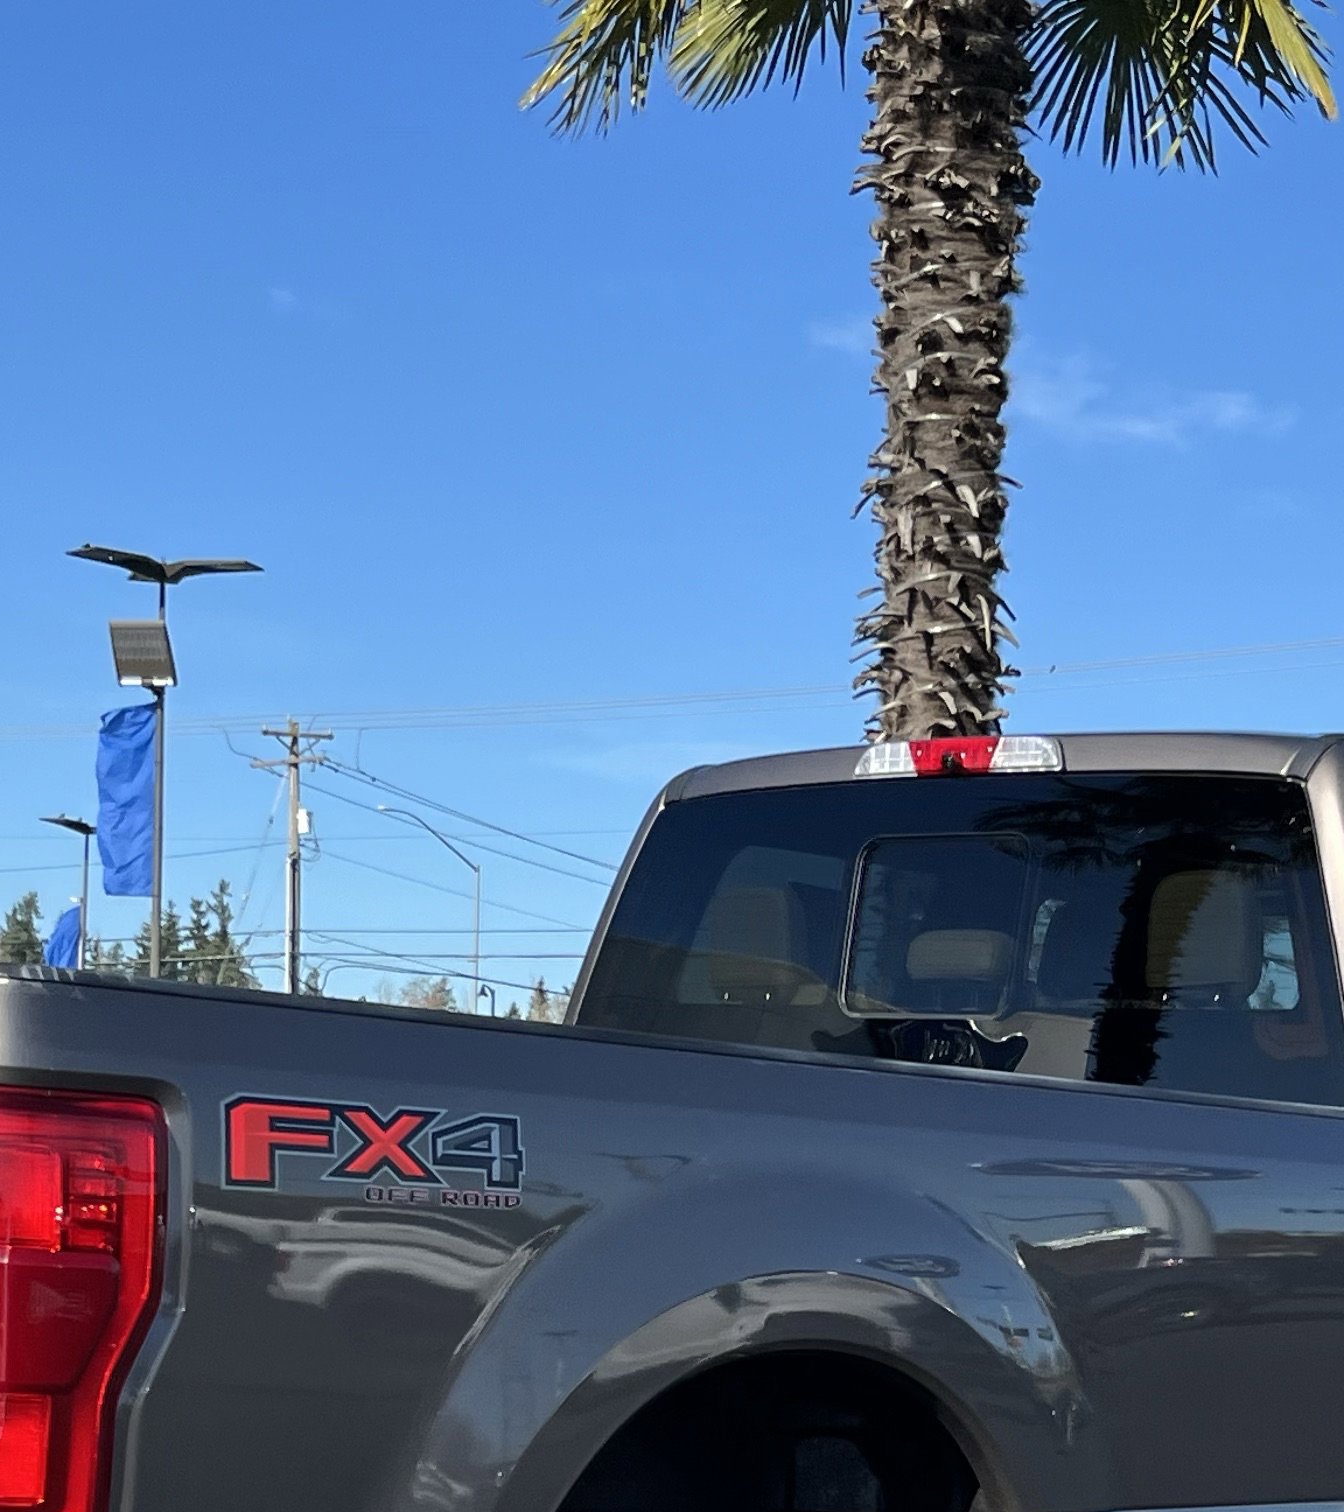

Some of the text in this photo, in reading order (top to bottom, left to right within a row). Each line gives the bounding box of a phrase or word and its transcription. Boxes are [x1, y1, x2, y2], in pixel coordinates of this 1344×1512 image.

[221, 1093, 525, 1193] FX4
[364, 1184, 522, 1210] OFF ROAD
